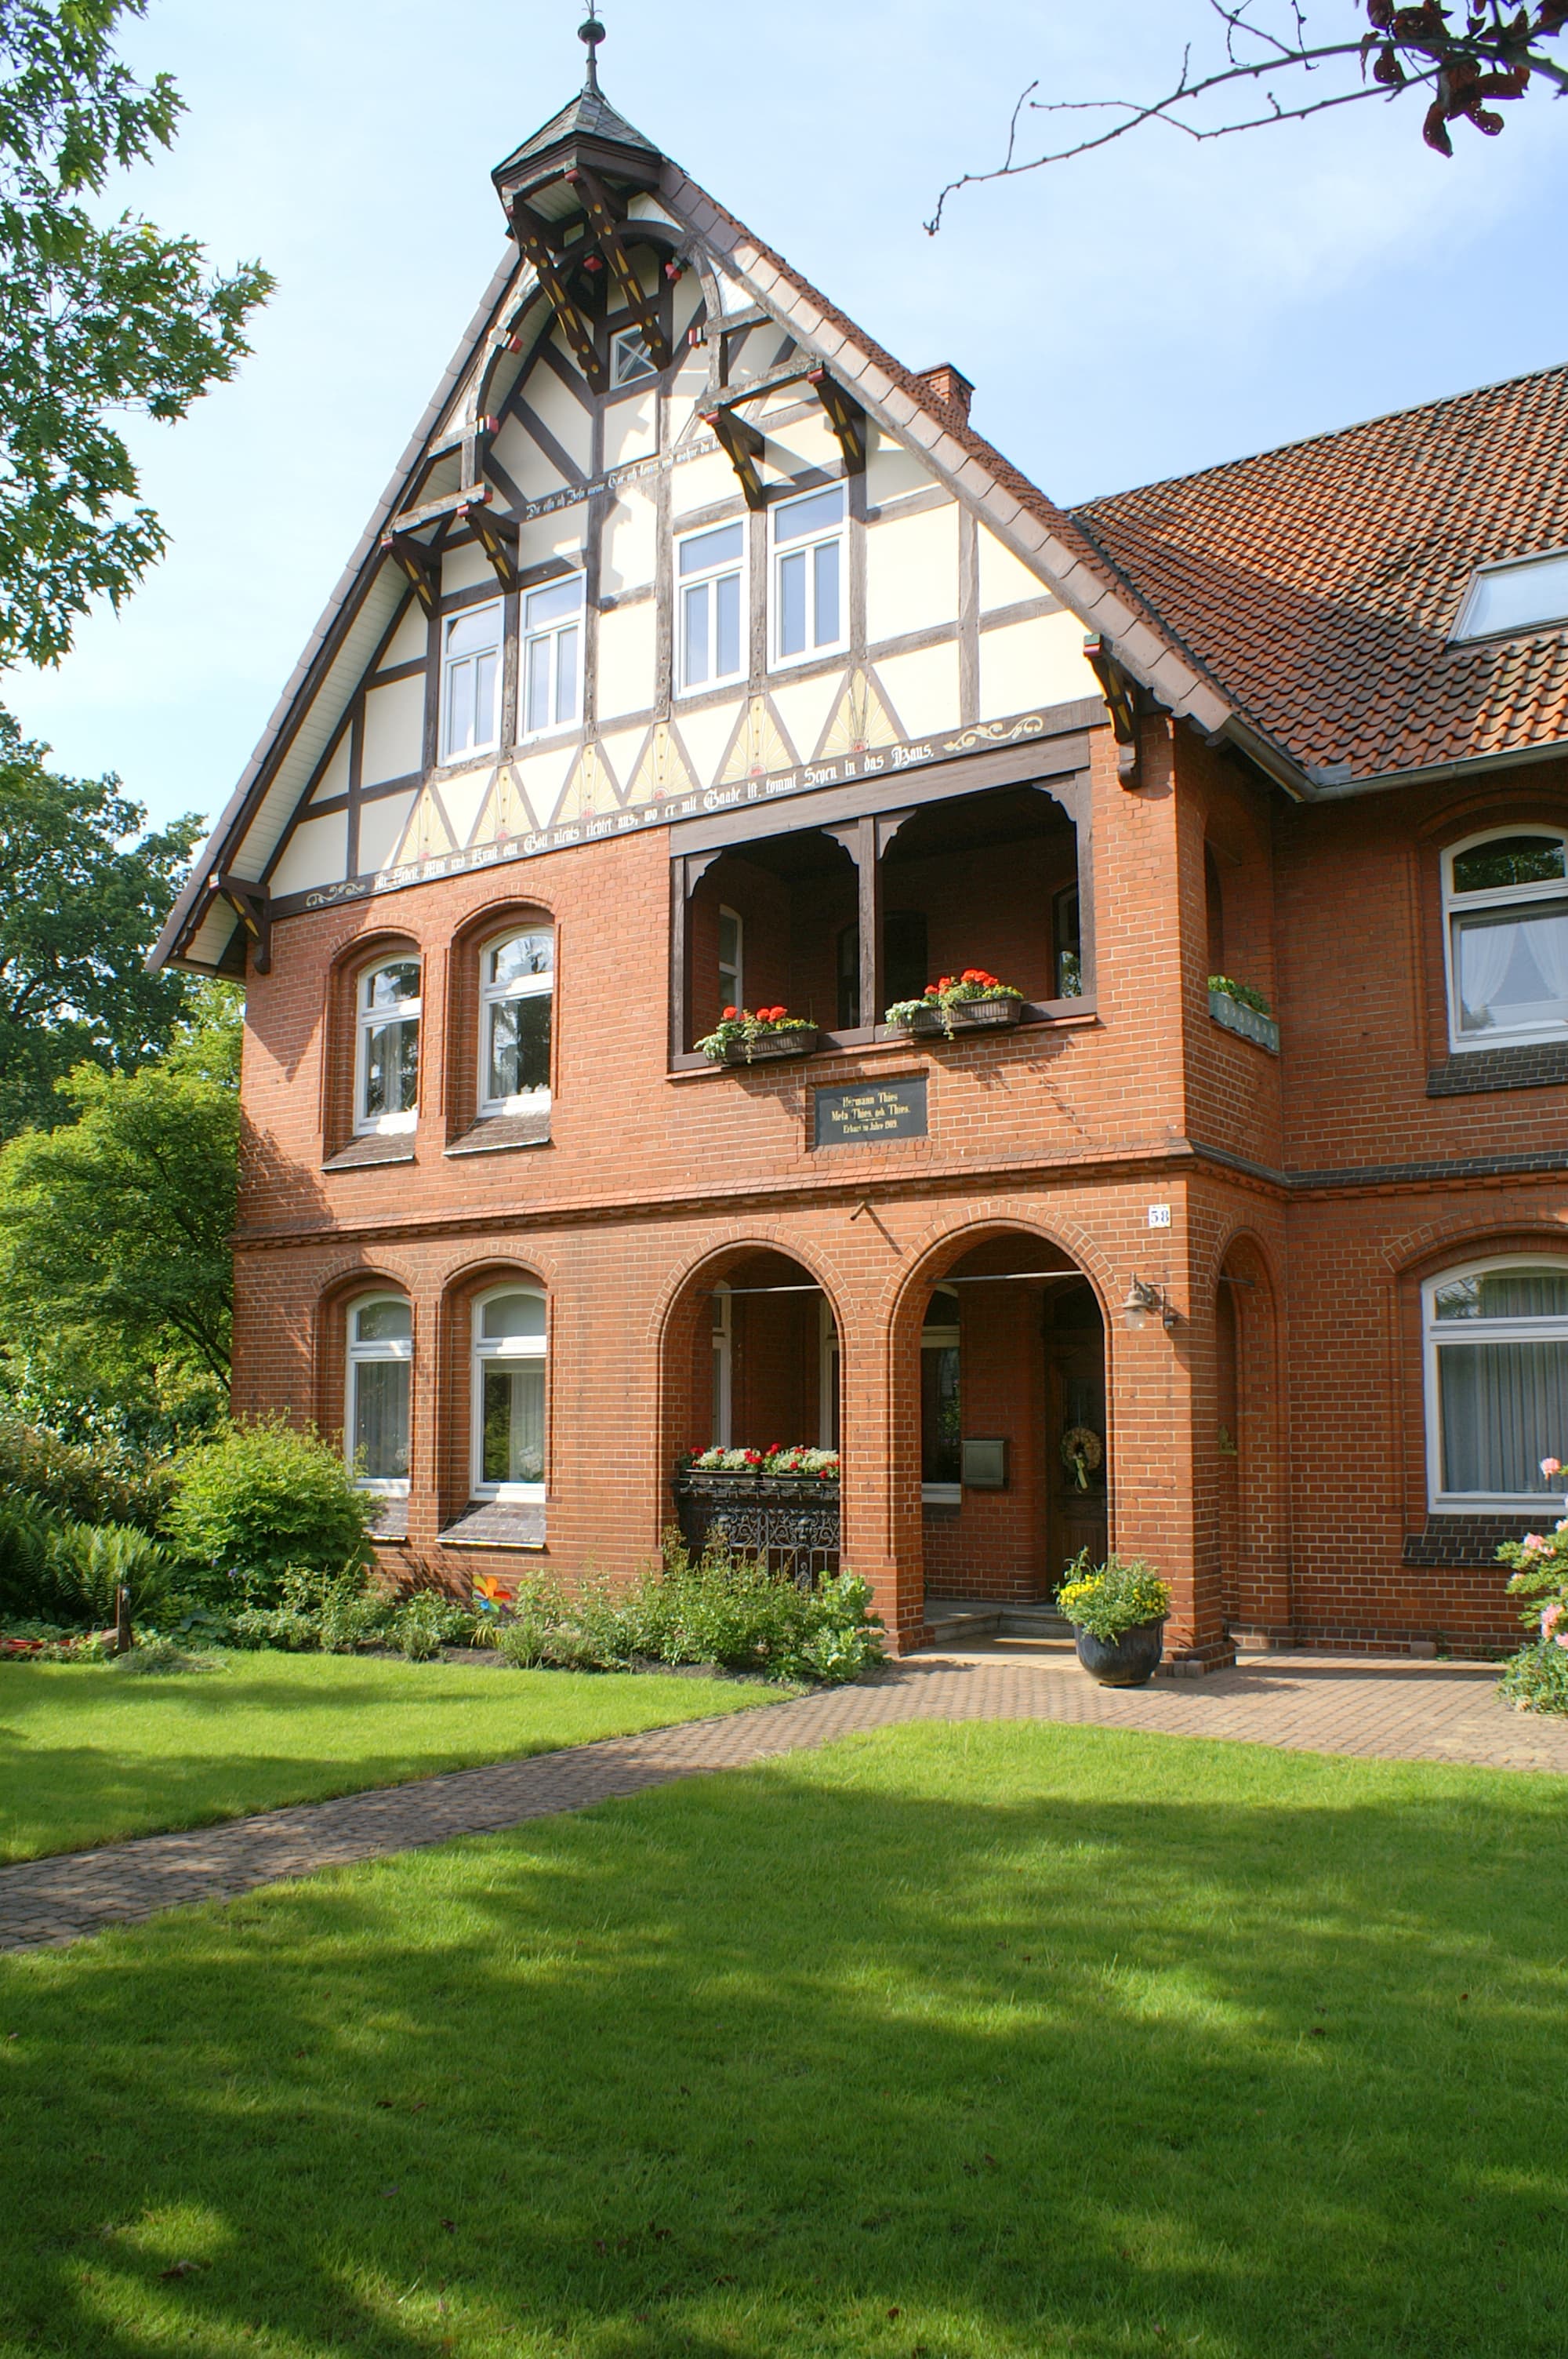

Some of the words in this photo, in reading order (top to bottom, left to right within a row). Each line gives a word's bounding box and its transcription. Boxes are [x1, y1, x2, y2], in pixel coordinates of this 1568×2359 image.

[524, 831, 548, 854] Gott
[644, 806, 659, 823] wo
[681, 794, 697, 813] mit
[703, 786, 741, 811] Gnade
[803, 766, 837, 788] Segen
[844, 758, 857, 777] in
[864, 754, 885, 772] das
[891, 743, 935, 769] Haus.
[843, 1096, 875, 1108] Hermann
[831, 1110, 849, 1122] Meta
[1151, 1209, 1170, 1223] 58
